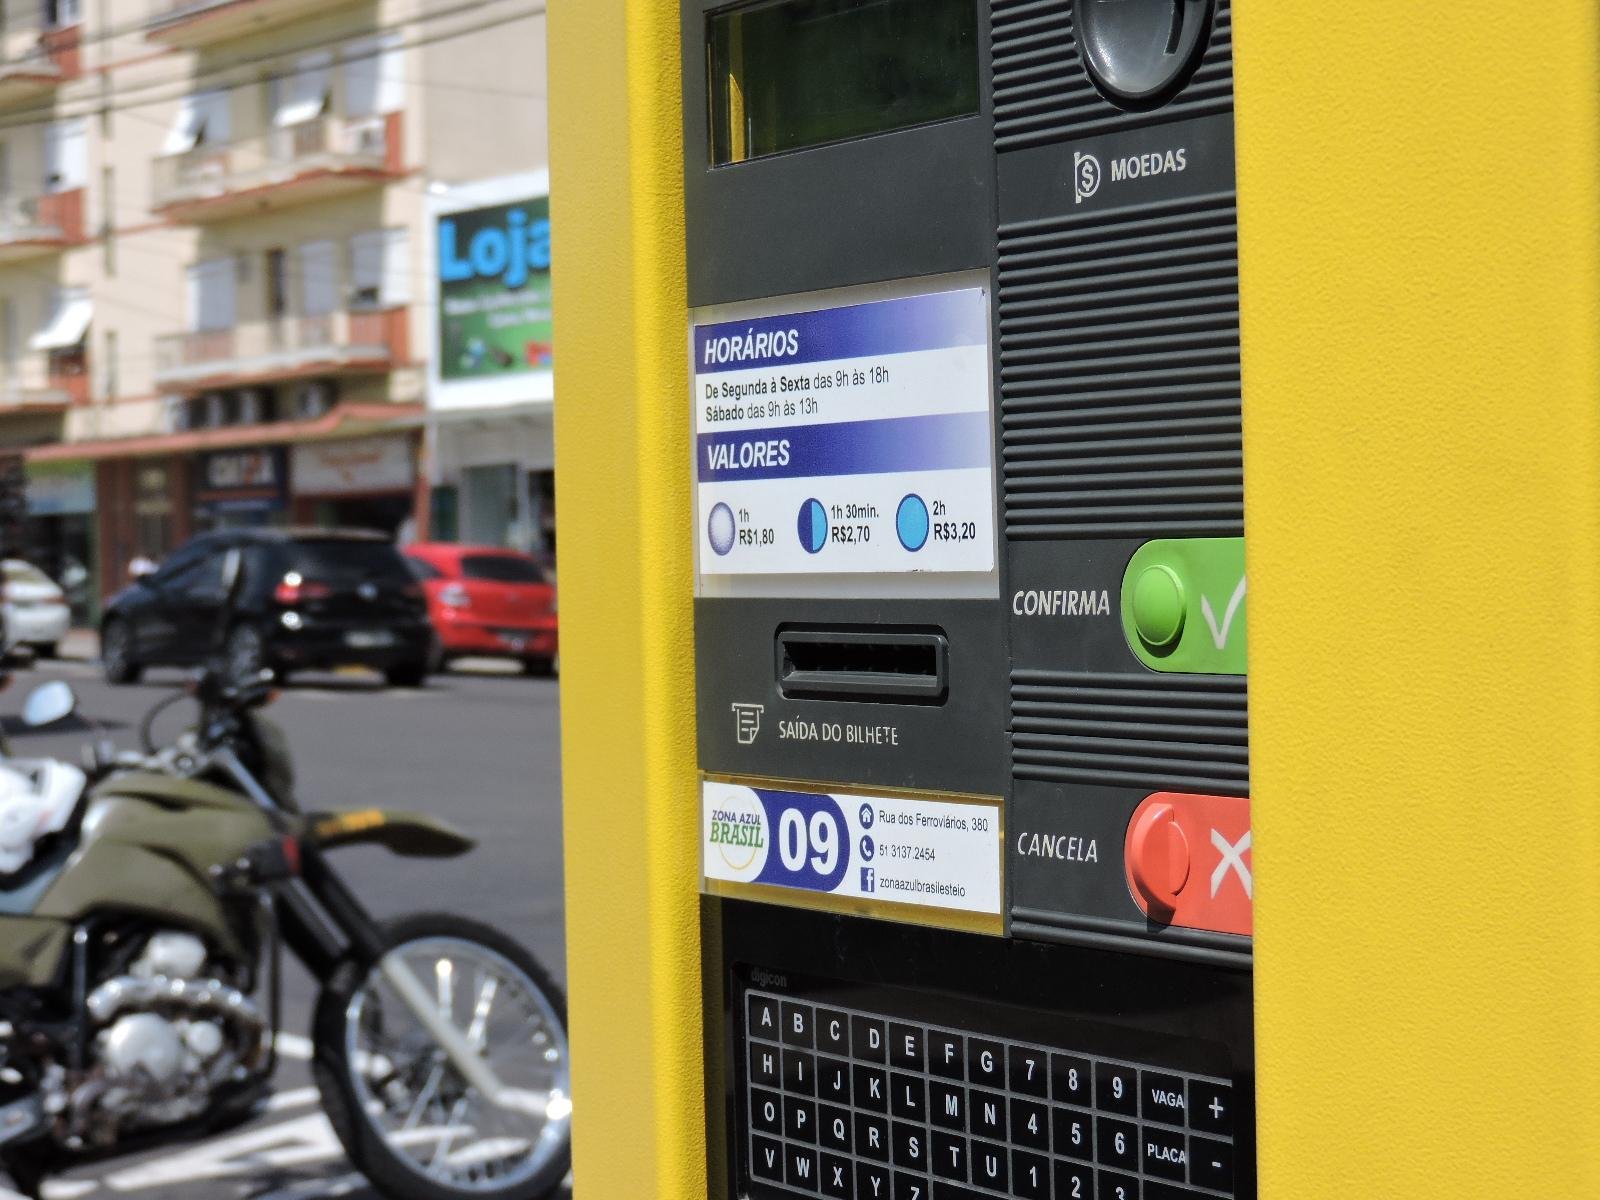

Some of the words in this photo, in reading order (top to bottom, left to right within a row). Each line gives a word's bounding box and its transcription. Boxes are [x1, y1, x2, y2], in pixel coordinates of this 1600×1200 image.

[1111, 148, 1186, 181] MOEDAS
[704, 329, 798, 363] HORÁRIOS
[705, 383, 719, 399] De
[721, 379, 768, 401] Segunda
[770, 376, 777, 393] à
[780, 374, 810, 393] Sexta
[813, 372, 833, 390] das
[835, 369, 849, 387] 9h
[852, 368, 866, 386] às
[869, 366, 889, 384] 18h
[706, 404, 744, 422] Sábado
[747, 401, 765, 419] das
[768, 400, 781, 417] 9h
[783, 399, 796, 416] às
[799, 397, 818, 414] 13h
[707, 439, 790, 470] VALORES
[738, 508, 749, 522] 1h
[831, 505, 843, 519] 1h
[846, 502, 879, 519] 30min.
[933, 500, 946, 516] 2h
[739, 528, 775, 546] R$1,80
[831, 526, 870, 545] R$2,70
[934, 521, 976, 541] R$3,20
[1012, 590, 1110, 616] CONFIRMA
[779, 715, 818, 741] SAÍDA
[822, 723, 841, 742] DO
[846, 724, 899, 746] BILHETE
[712, 810, 737, 823] ZONA
[739, 813, 762, 826] AZUL
[879, 810, 896, 824] Rua
[898, 812, 914, 826] dos
[916, 813, 969, 832] Ferroviários,
[972, 818, 988, 832] 380
[710, 822, 764, 848] BRASIL
[779, 807, 839, 875] 09
[1017, 831, 1098, 864] CANCELA
[879, 844, 888, 857] 51
[891, 845, 936, 861] 3137.2454
[880, 878, 966, 897] zonaazulbrasilesteio
[761, 1006, 772, 1027] A
[793, 1012, 804, 1034] B
[829, 1020, 840, 1041] C
[869, 1027, 880, 1049] D
[904, 1035, 915, 1057] E
[944, 1043, 954, 1064] F
[980, 1050, 993, 1073] G
[1025, 1059, 1035, 1081] 7
[1068, 1068, 1078, 1091] 8
[1112, 1076, 1123, 1099] 9
[1152, 1089, 1184, 1108] VAGA
[762, 1053, 773, 1074] H
[798, 1061, 803, 1081] I
[833, 1070, 841, 1090] J
[869, 1077, 881, 1099] K
[905, 1085, 916, 1107] L
[945, 1093, 958, 1117] M
[984, 1102, 996, 1125] N
[1027, 1113, 1038, 1135] 4
[1071, 1122, 1081, 1145] 5
[1114, 1131, 1125, 1155] 6
[1148, 1144, 1185, 1163] PLACA
[764, 1101, 775, 1122] O
[797, 1109, 806, 1129] P
[833, 1118, 845, 1141] Q
[868, 1126, 880, 1149] R
[908, 1136, 919, 1158] S
[949, 1145, 960, 1168] T
[985, 1155, 997, 1178] U
[1029, 1165, 1037, 1188] 1
[1071, 1175, 1081, 1199] 2
[764, 1147, 775, 1168] V
[796, 1156, 810, 1178] W
[832, 1166, 843, 1188] X
[870, 1175, 881, 1197] Y
